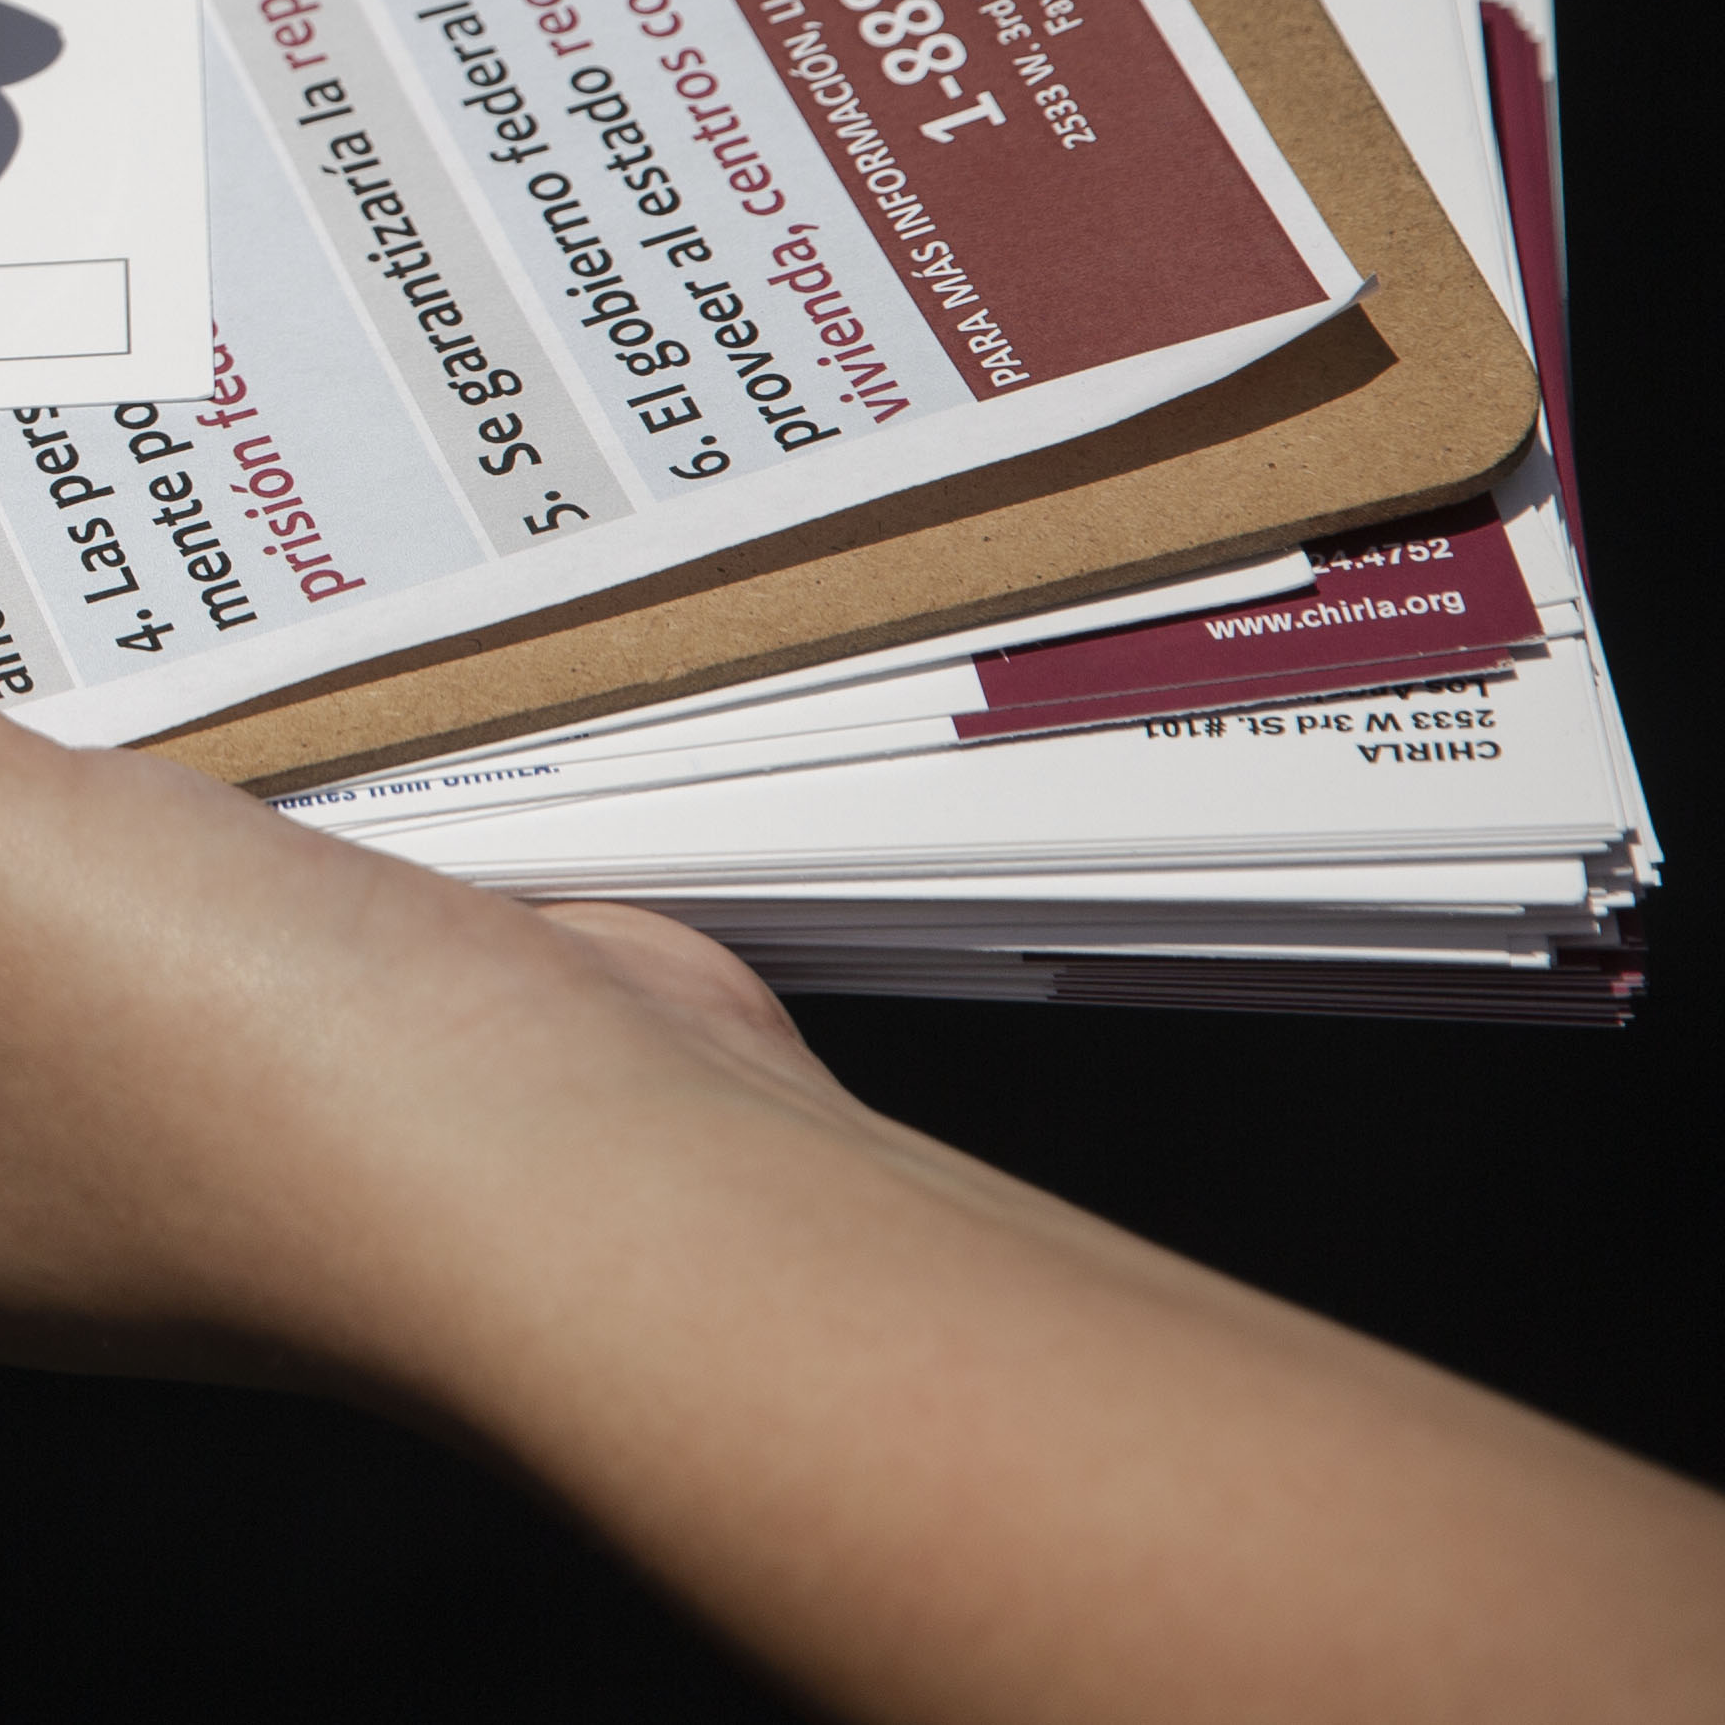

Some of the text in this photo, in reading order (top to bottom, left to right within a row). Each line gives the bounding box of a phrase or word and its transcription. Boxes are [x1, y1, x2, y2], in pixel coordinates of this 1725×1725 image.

[417, 0, 550, 164] federal
[1013, 42, 1055, 87] W.
[298, 79, 354, 126] la
[660, 48, 786, 216] centros
[784, 21, 936, 241] INFORMACIÓN,
[1035, 84, 1097, 150] 2533
[566, 67, 682, 217] estado
[321, 131, 523, 406] garantizaría
[527, 172, 691, 377] gobierno
[639, 225, 713, 268] al
[911, 240, 980, 310] MÁS
[766, 224, 911, 424] vivienda,
[957, 308, 1030, 388] PARA
[684, 281, 842, 453] proveer
[478, 412, 543, 476] Se
[626, 383, 703, 435] El
[668, 435, 731, 480] 6.
[229, 434, 367, 603] prisión
[522, 490, 590, 536] 5.
[67, 517, 140, 604] Las
[148, 471, 258, 632] mente
[115, 608, 174, 653] 4.
[1205, 590, 1466, 641] www.chirla.org
[1146, 709, 1495, 739] 2533 W 3rd St. #101
[1356, 740, 1502, 764] CHIRLA
